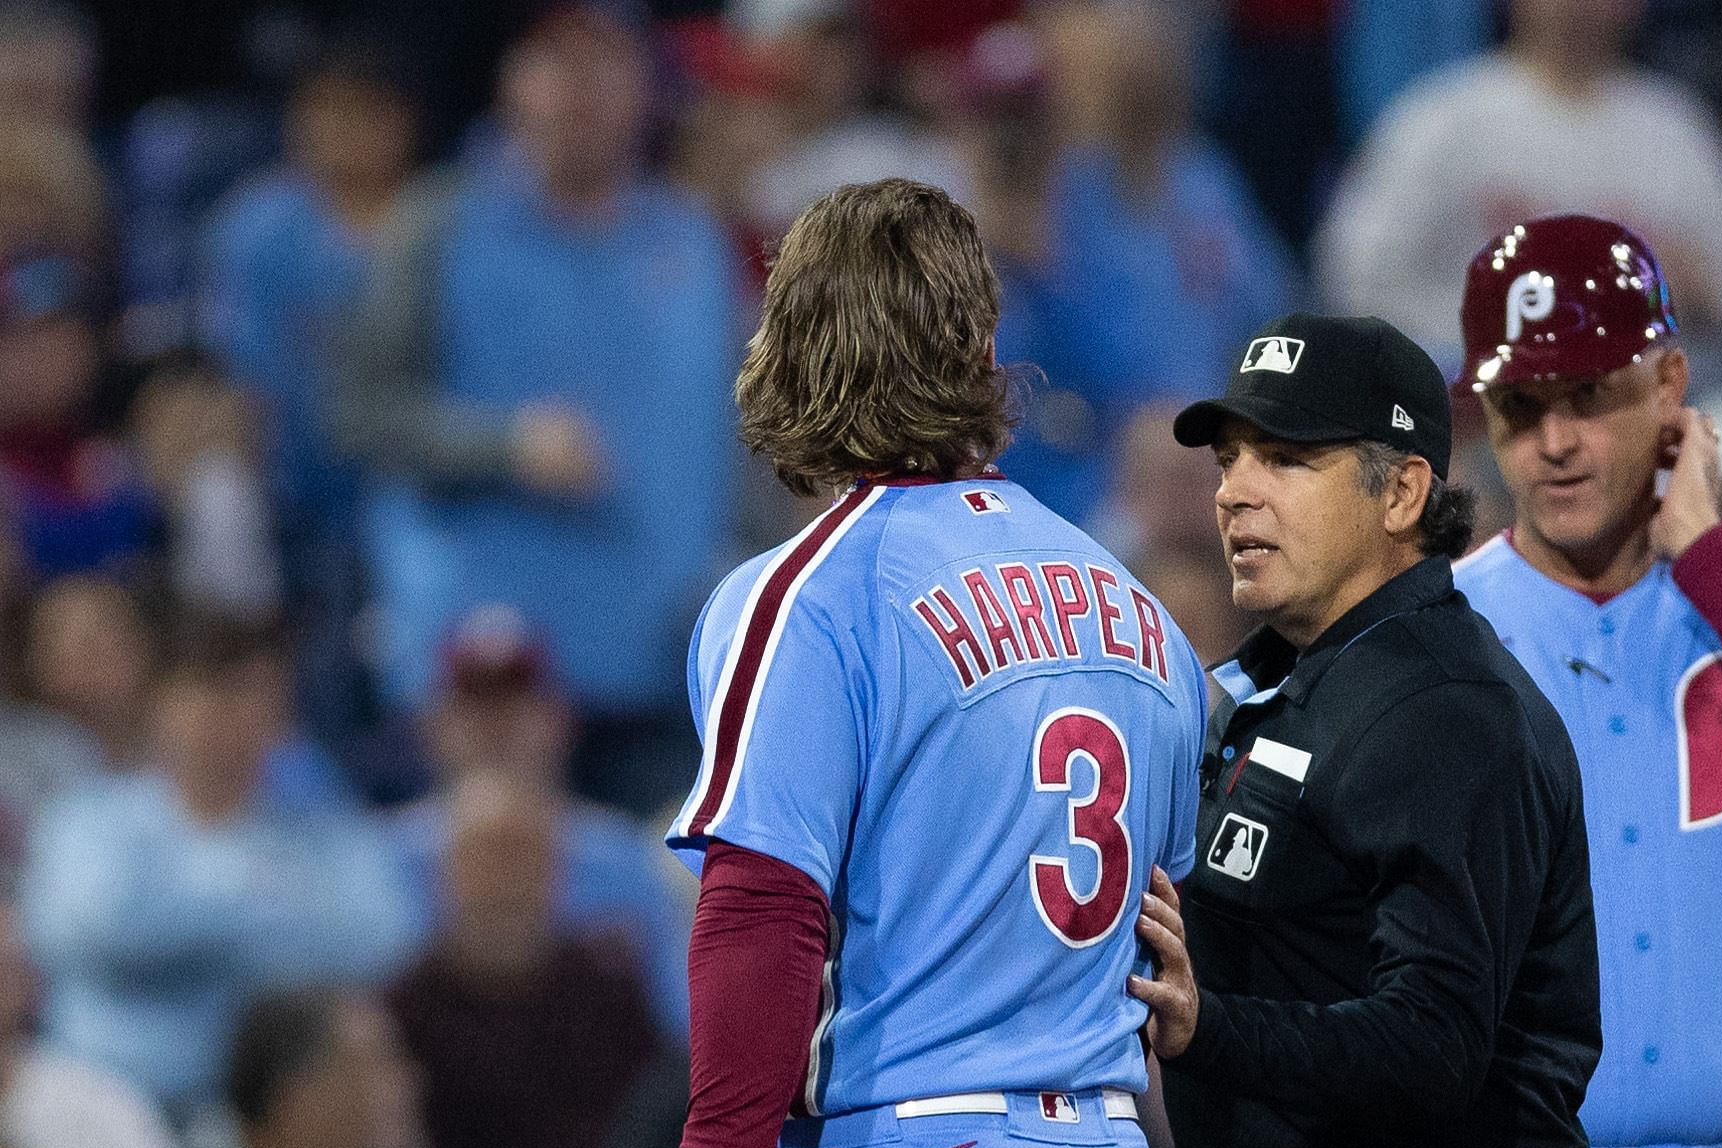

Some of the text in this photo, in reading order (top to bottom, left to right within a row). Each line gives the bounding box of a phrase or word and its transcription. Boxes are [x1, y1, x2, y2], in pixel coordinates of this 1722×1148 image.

[1506, 271, 1556, 342] P
[910, 561, 1170, 692] HARPER
[1029, 706, 1133, 949] 3
